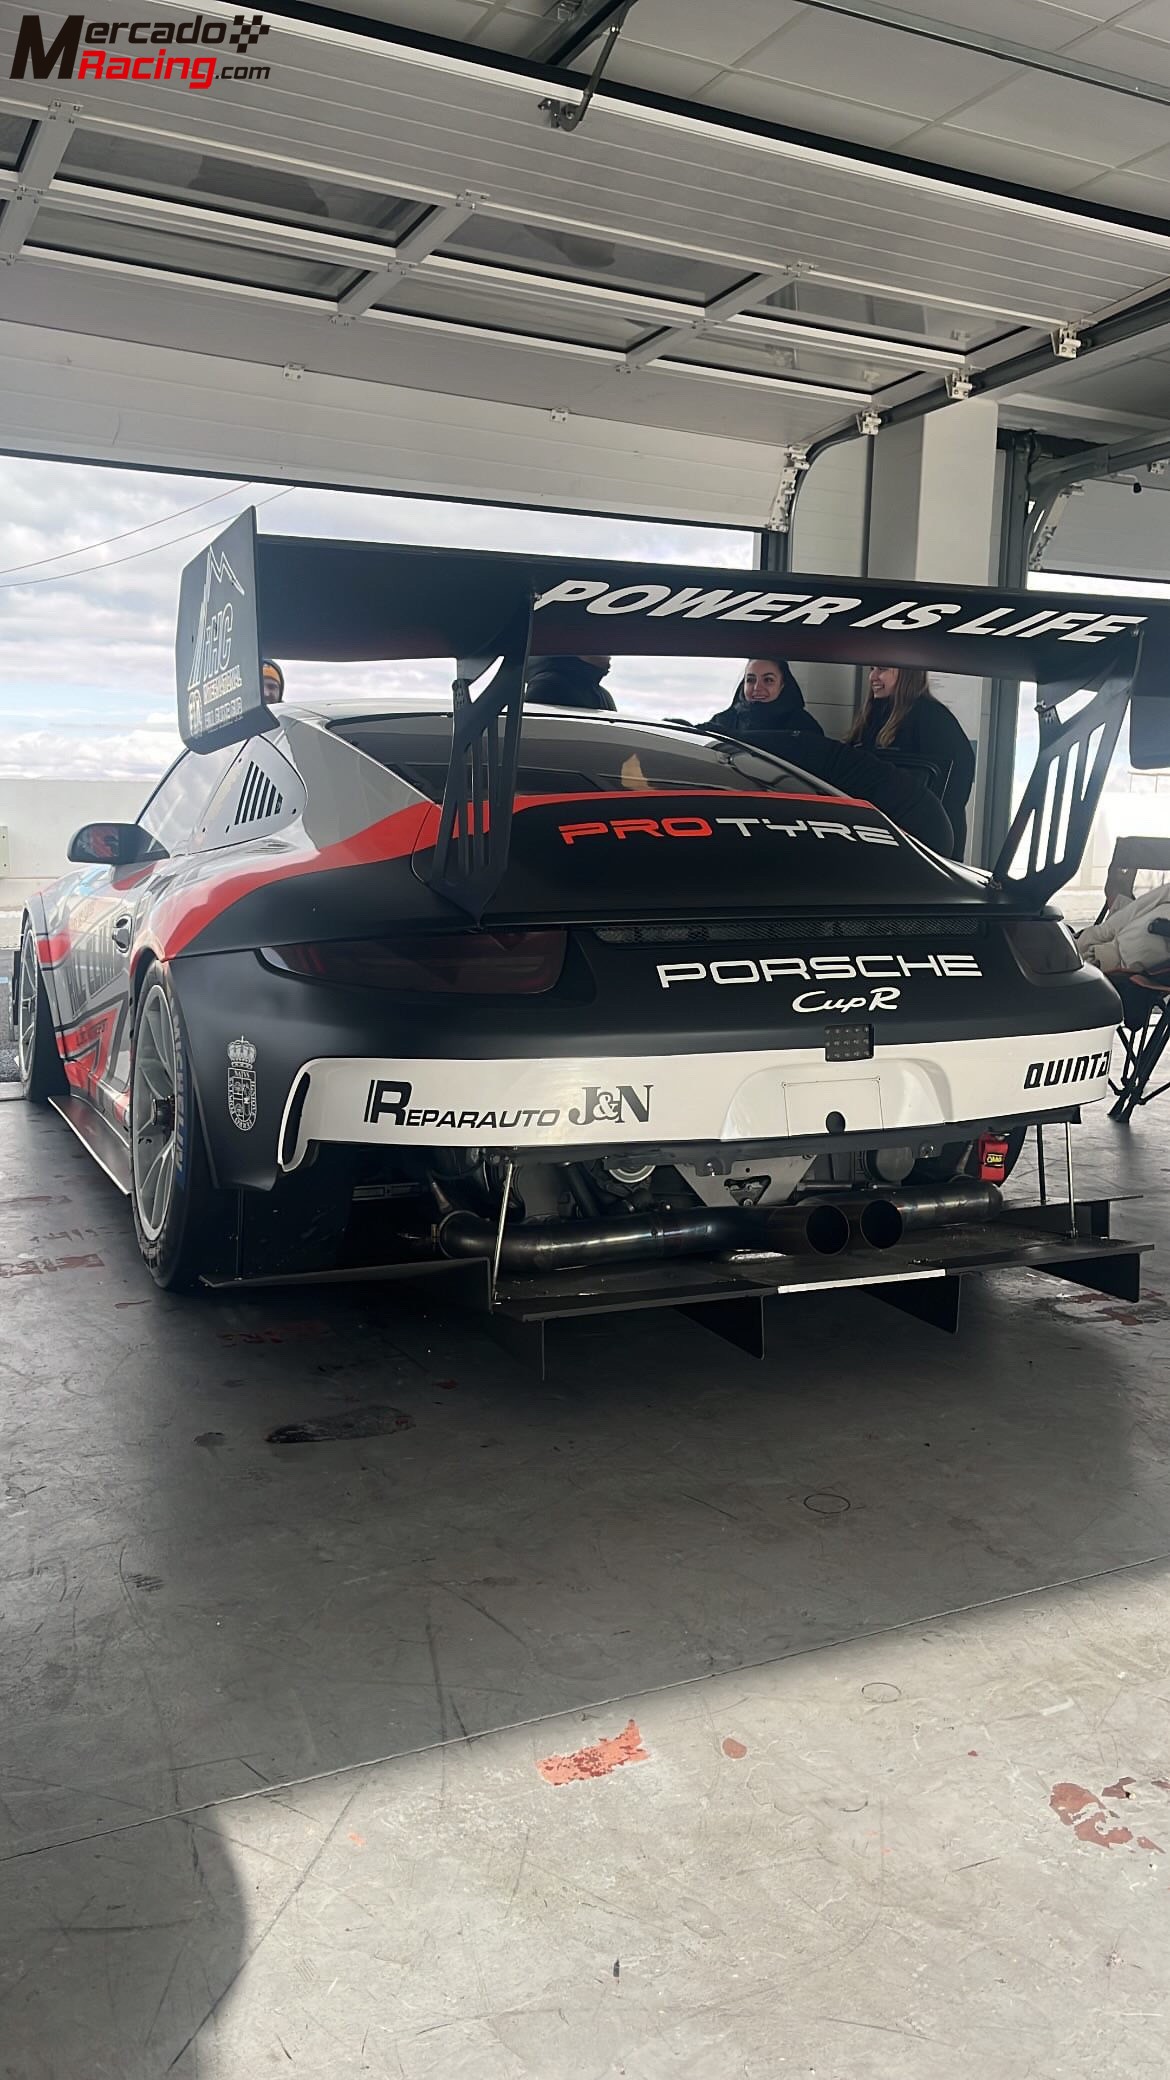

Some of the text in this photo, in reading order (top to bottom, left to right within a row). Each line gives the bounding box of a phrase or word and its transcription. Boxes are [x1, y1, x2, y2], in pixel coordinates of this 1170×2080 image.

[533, 579, 1149, 643] POWER IS LIFE
[657, 955, 983, 988] PORSCHE
[792, 986, 900, 1013] Cup R
[1024, 1049, 1112, 1089] QUINTA
[568, 1085, 654, 1124] J&N
